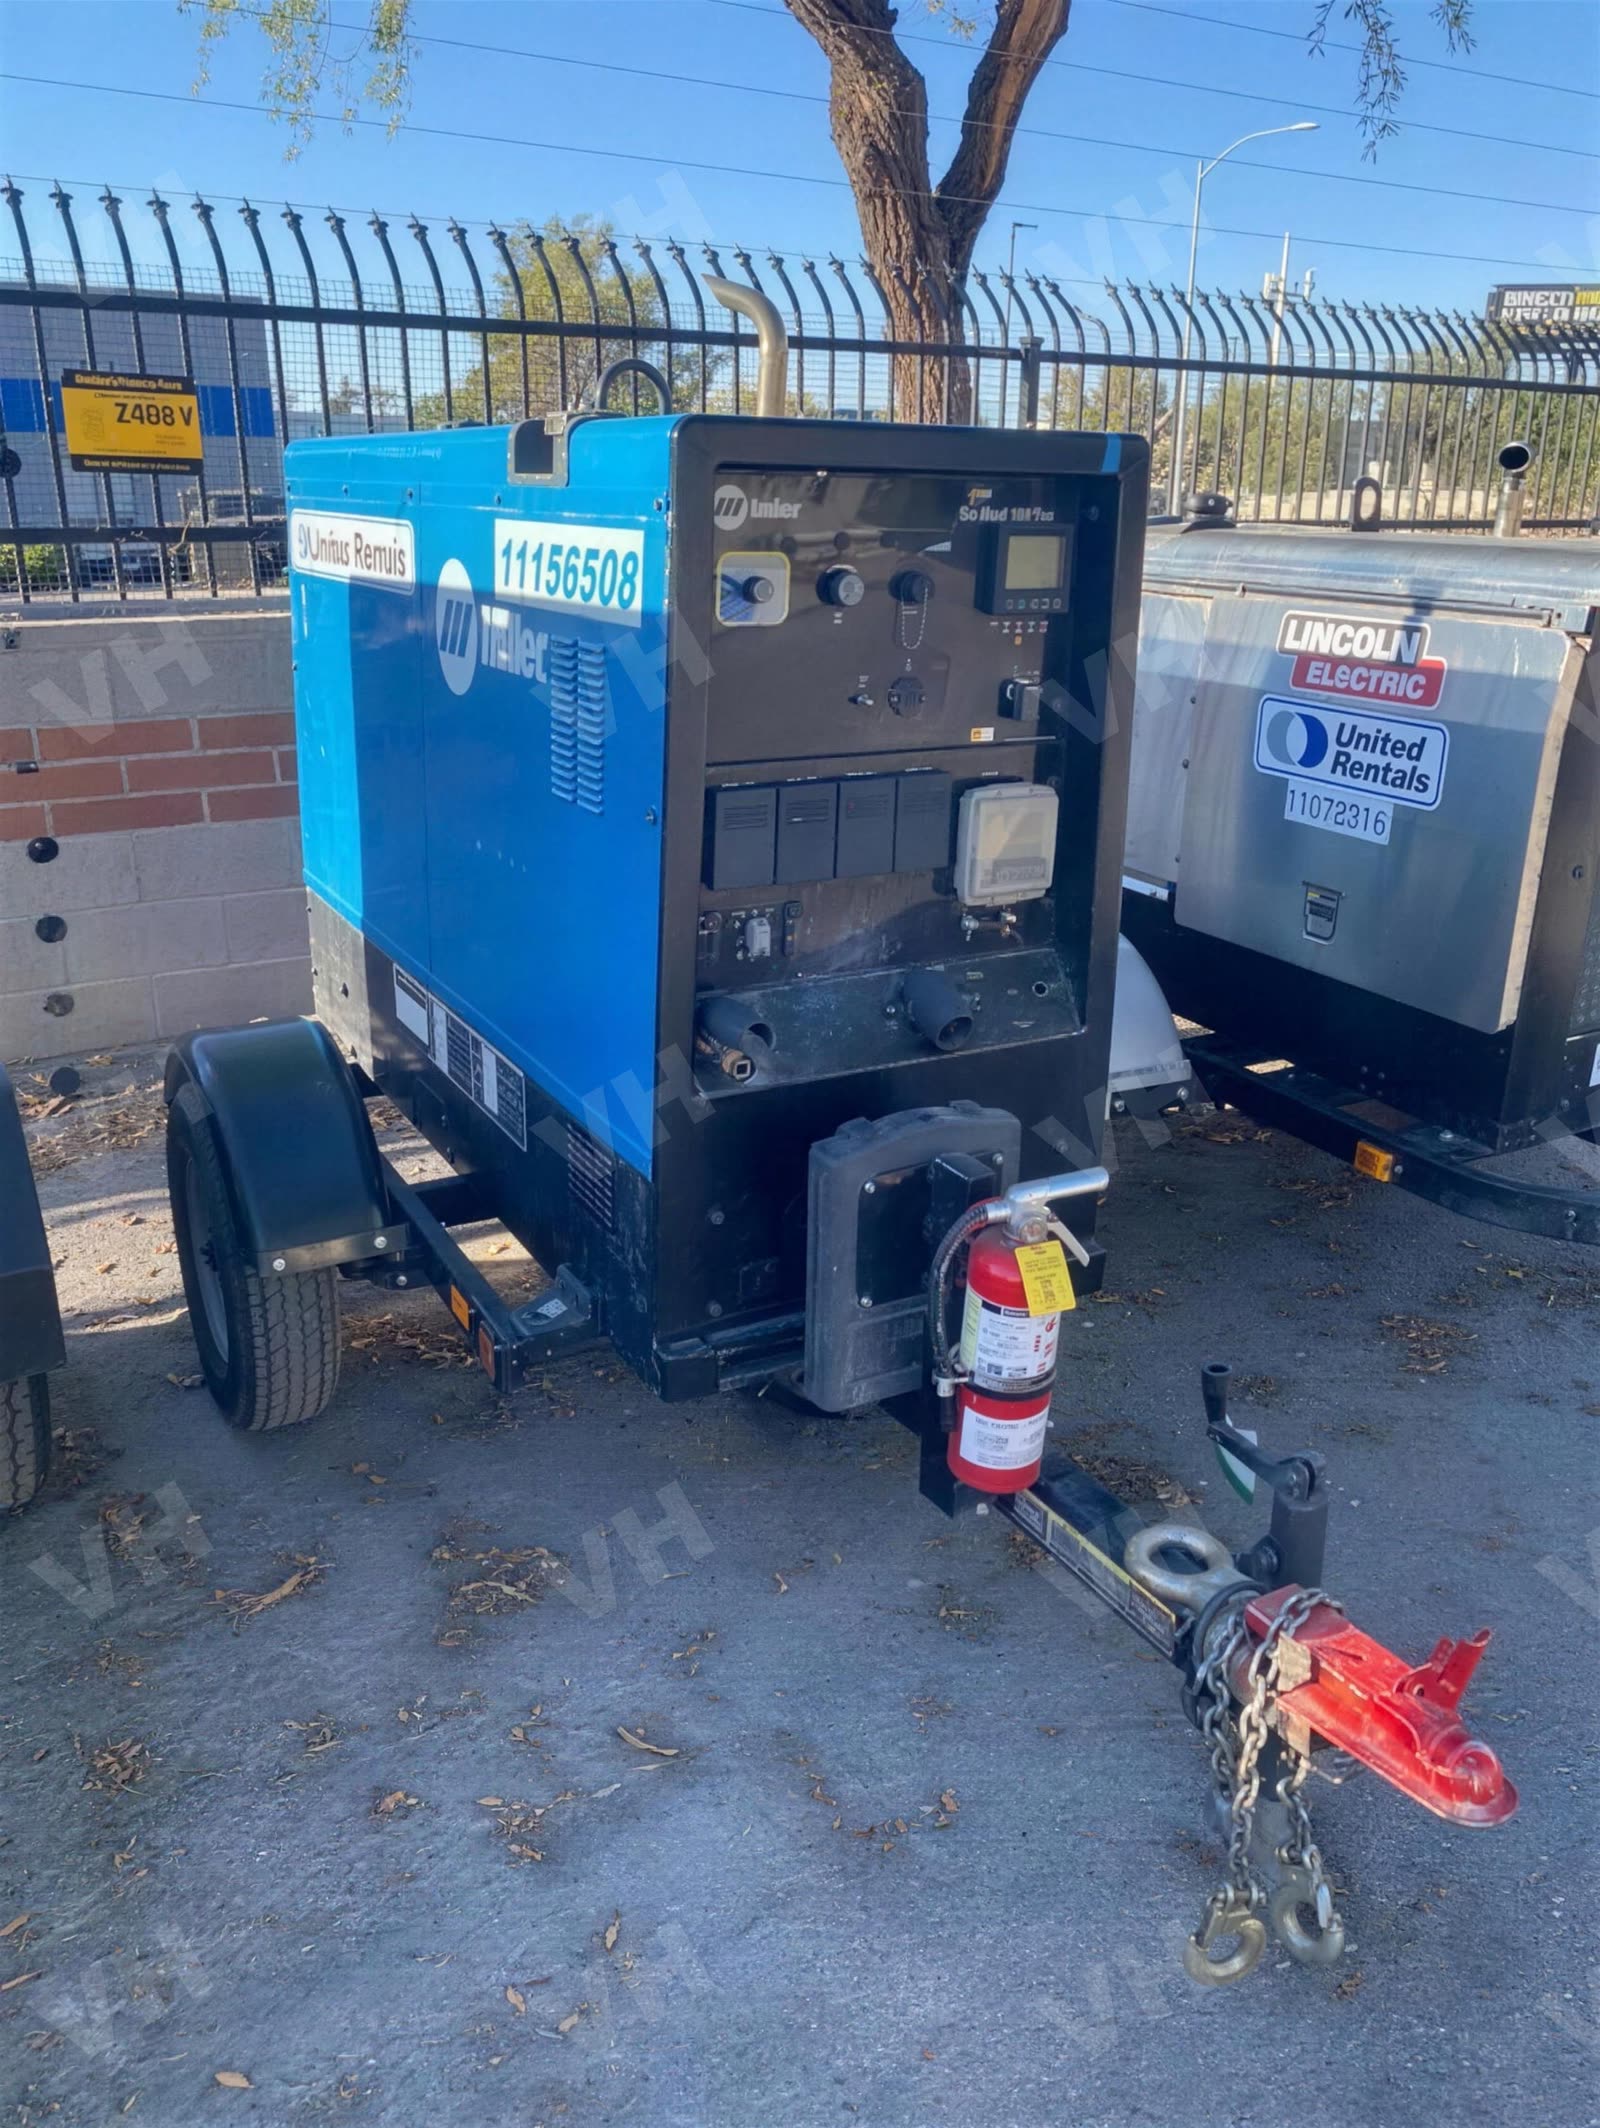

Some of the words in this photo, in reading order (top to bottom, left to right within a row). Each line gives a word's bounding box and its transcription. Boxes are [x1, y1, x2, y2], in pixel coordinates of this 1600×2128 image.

[501, 537, 640, 611] 11156508
[1284, 618, 1421, 664] LINCOLN
[1335, 722, 1427, 762] United
[1330, 750, 1431, 794] Rentals
[1289, 788, 1387, 836] 11072316
